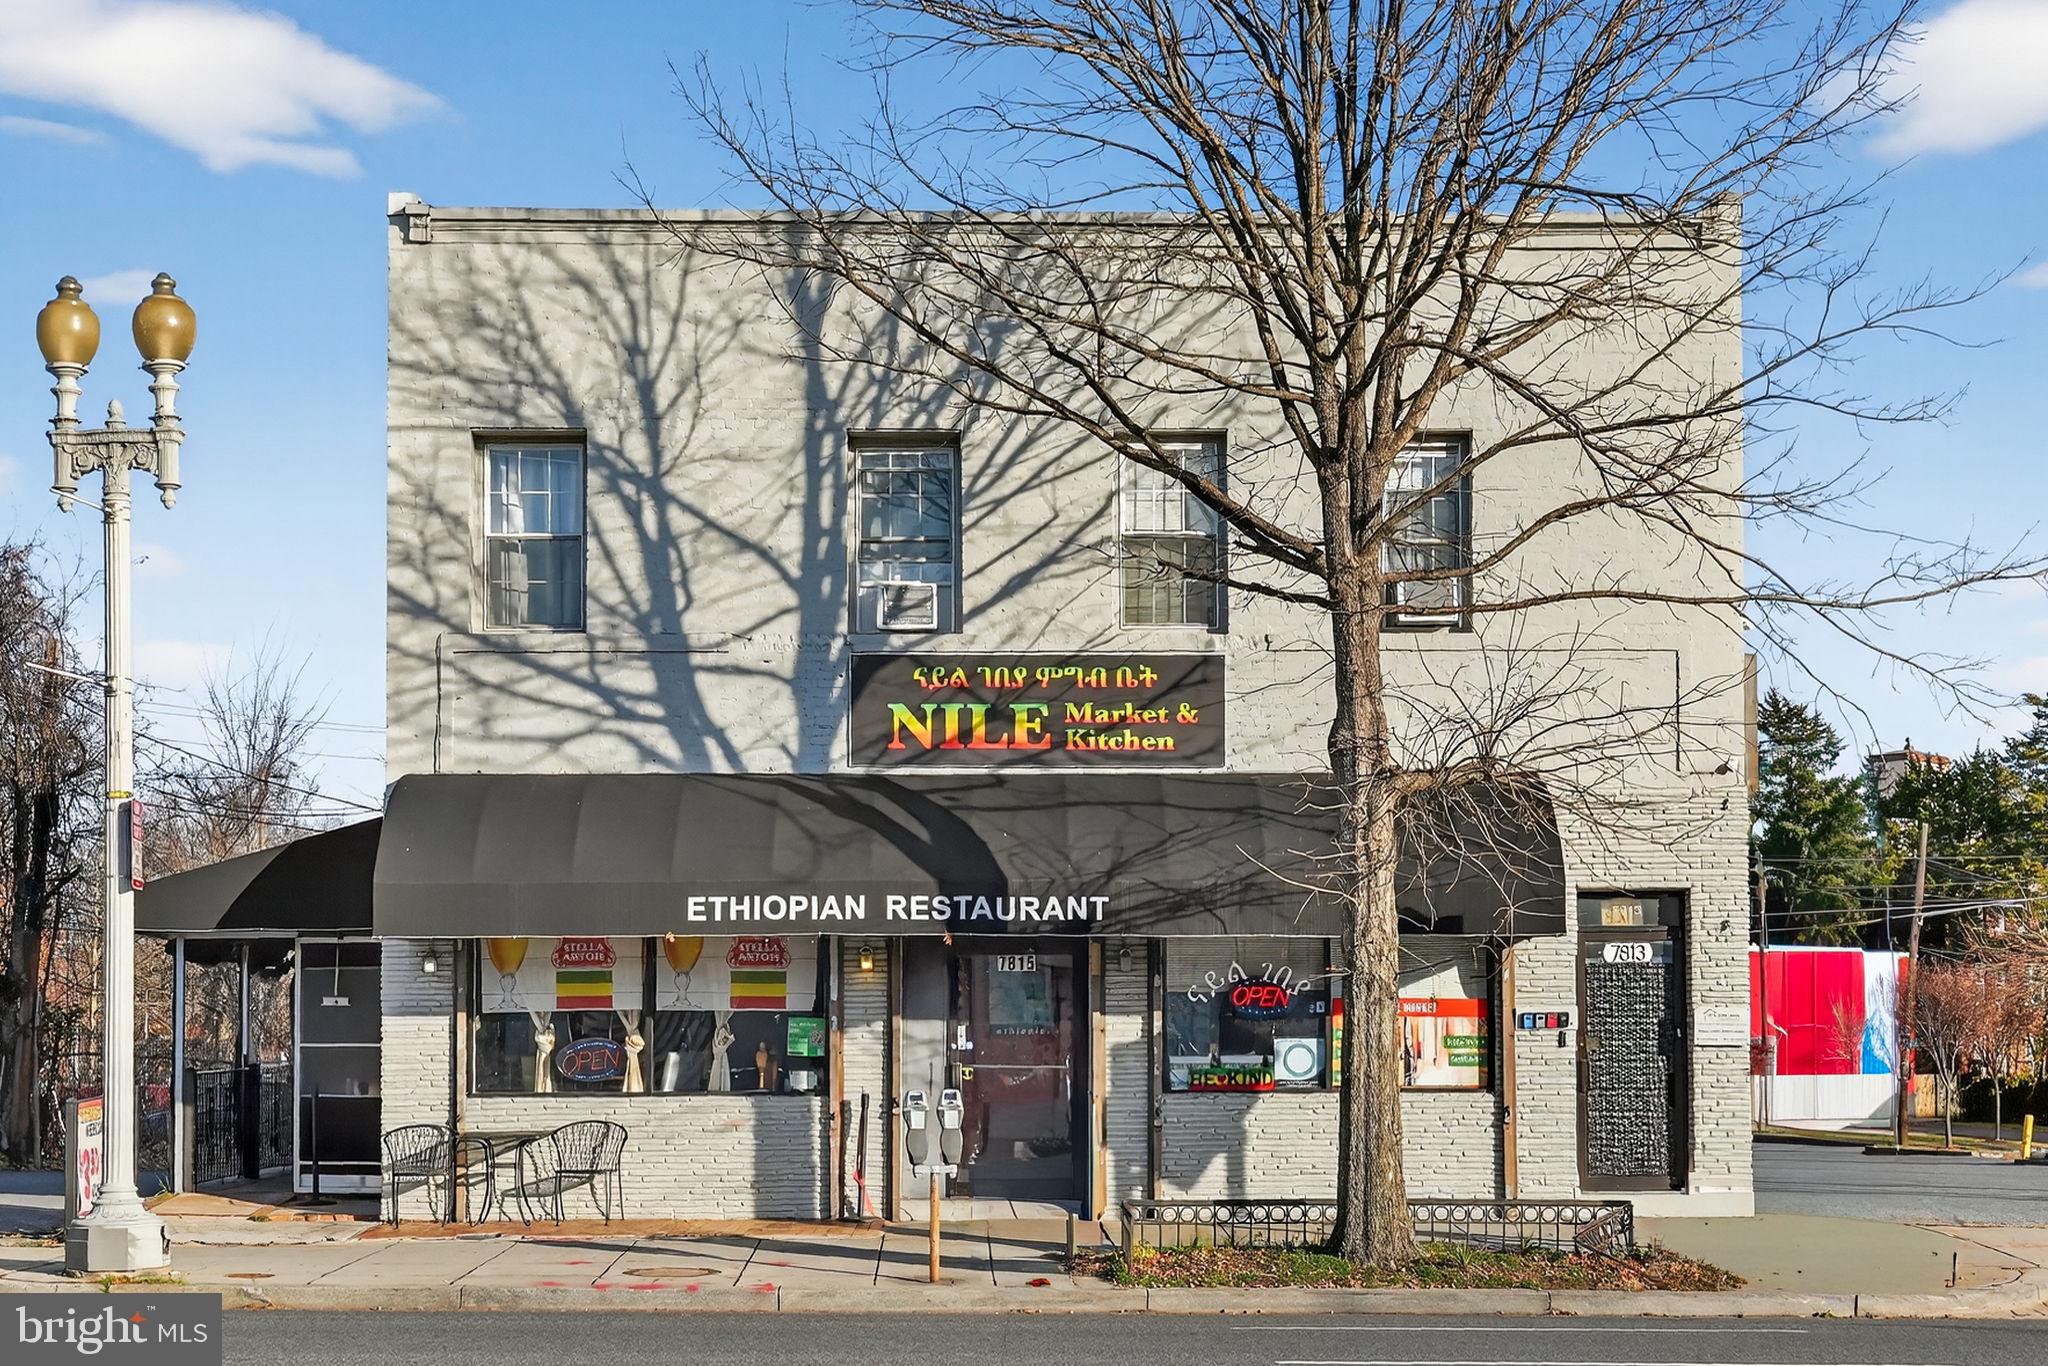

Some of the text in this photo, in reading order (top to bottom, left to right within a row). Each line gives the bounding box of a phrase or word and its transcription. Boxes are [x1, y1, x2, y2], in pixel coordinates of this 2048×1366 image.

[913, 666, 970, 690] ናይል
[1116, 664, 1158, 688] ቤት
[1064, 702, 1199, 723] Market &
[887, 703, 1051, 750] NILE
[1064, 729, 1175, 750] Kitchen
[687, 895, 1110, 921] ETHIOPIAN RESTAURANT
[998, 955, 1036, 971] 7815
[1610, 944, 1646, 962] 7813
[1232, 986, 1290, 1007] OPEN
[562, 1048, 622, 1075] OPEN
